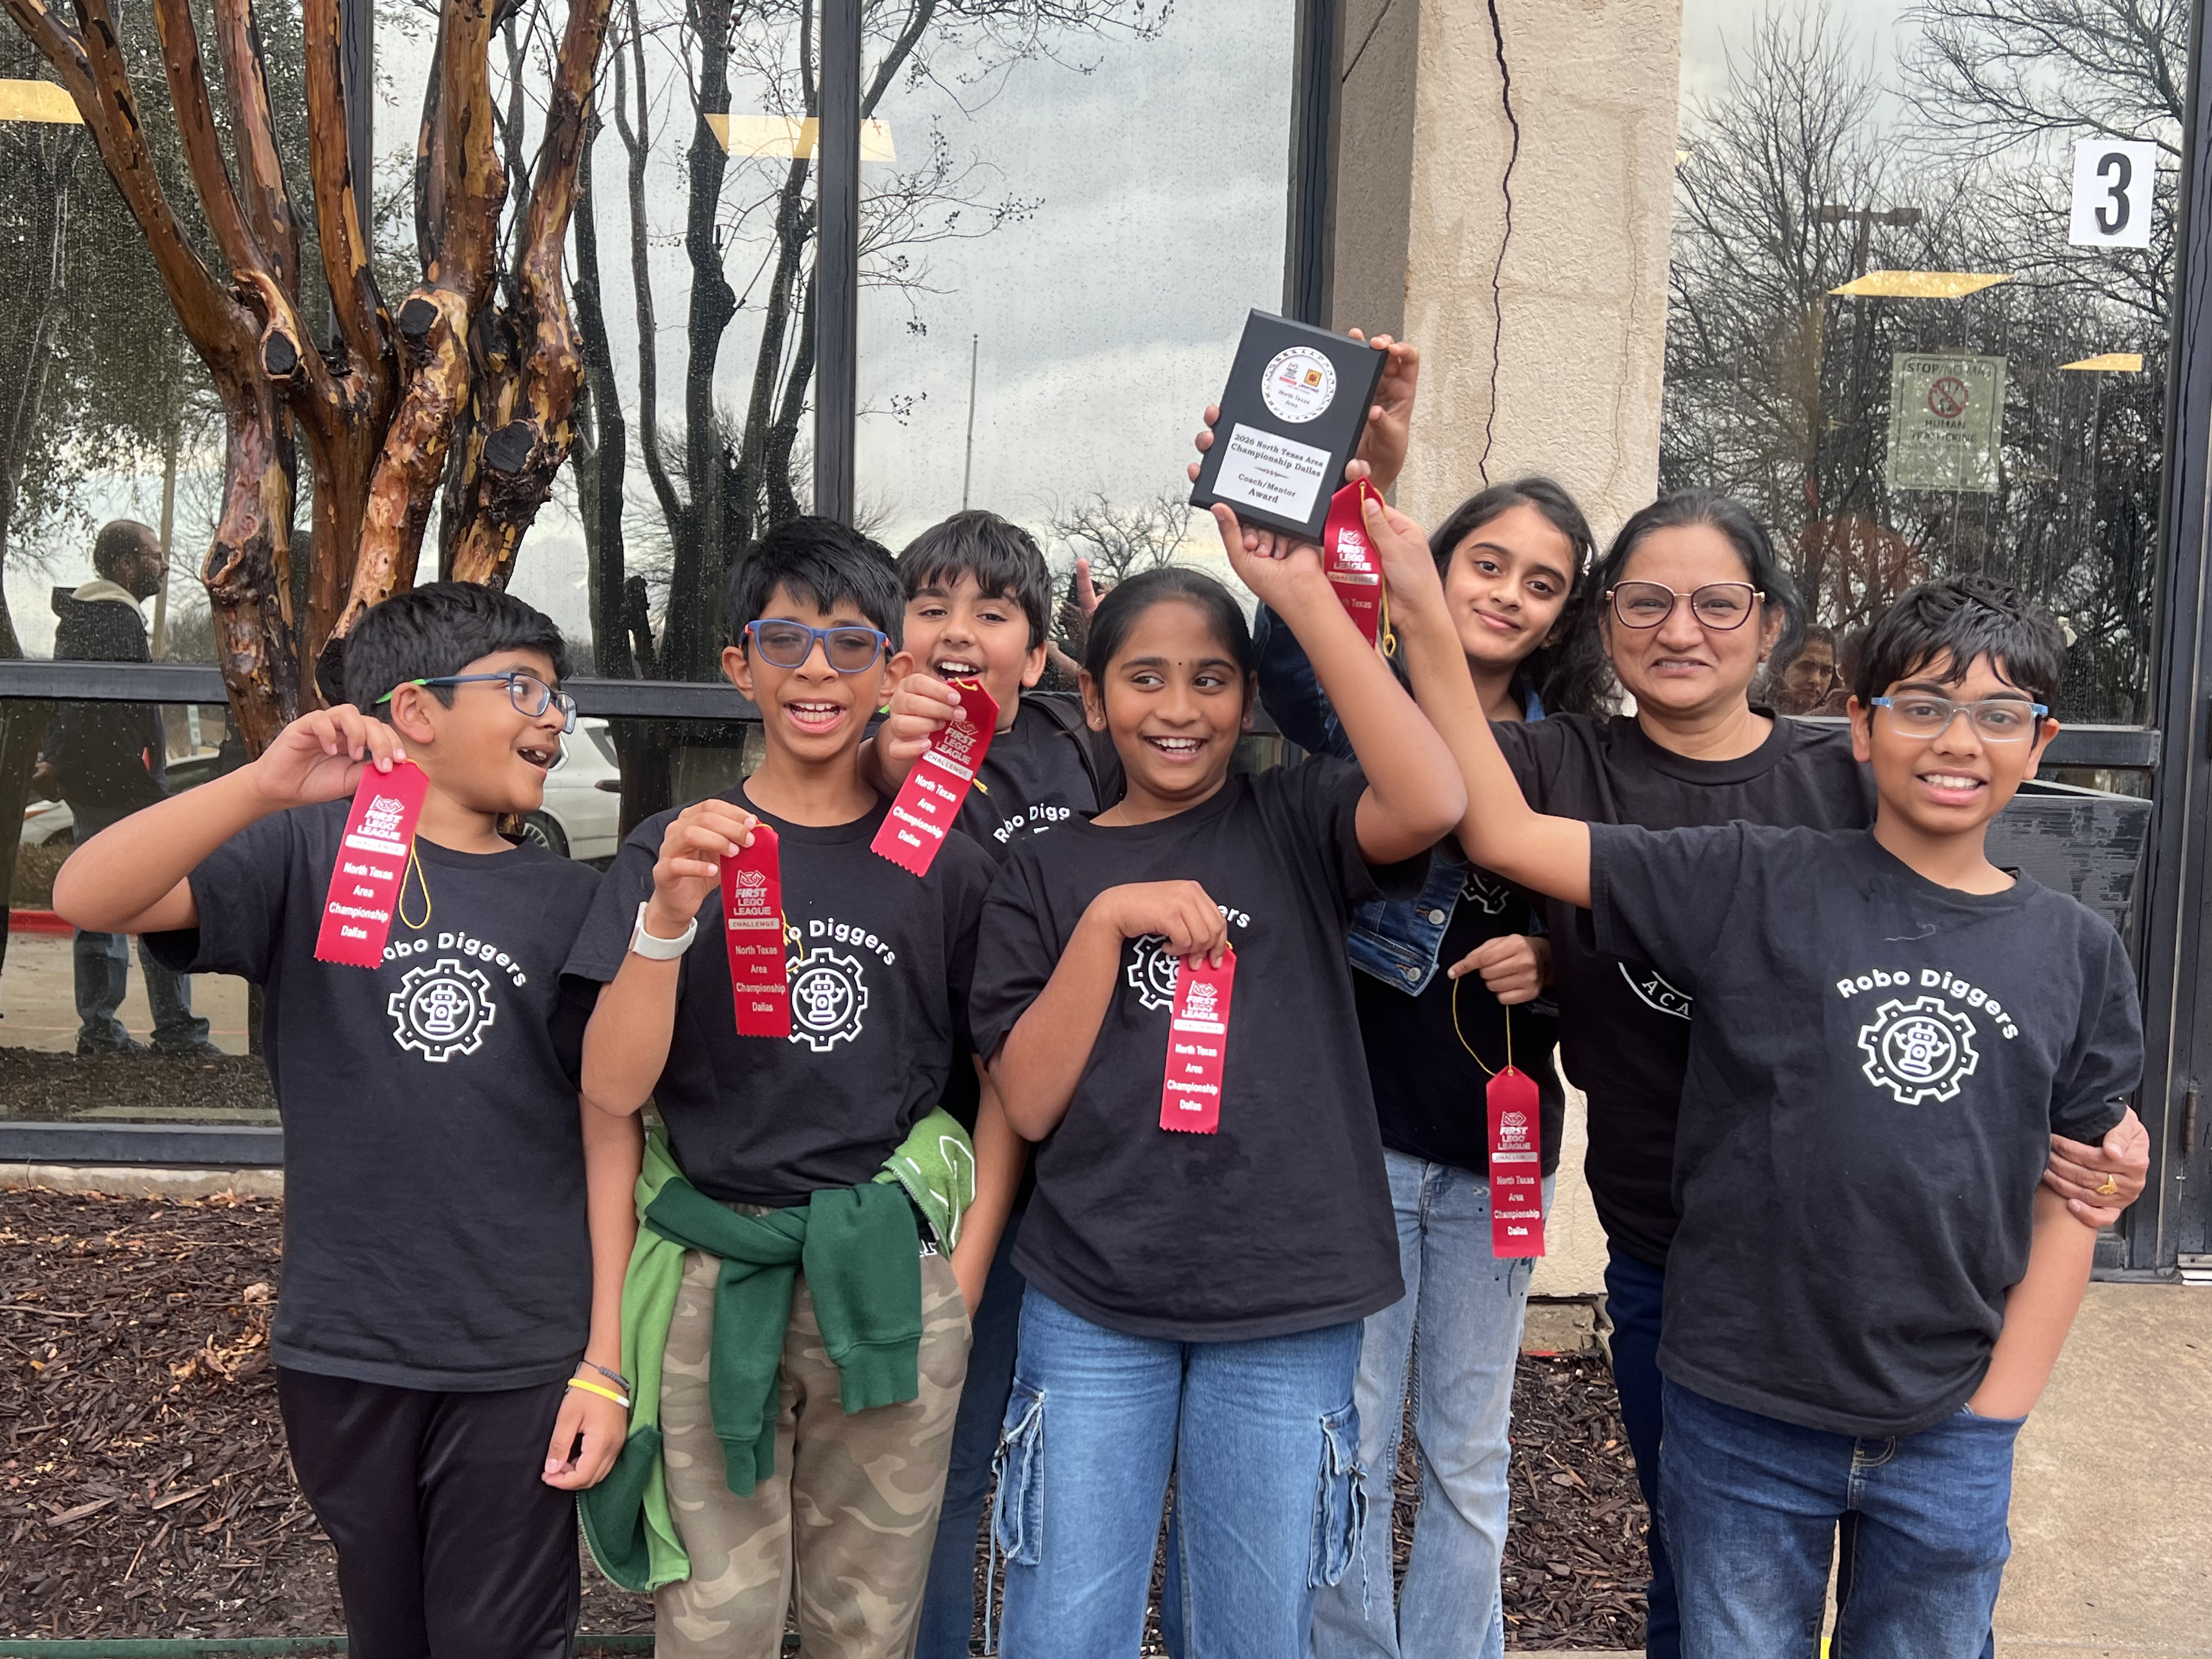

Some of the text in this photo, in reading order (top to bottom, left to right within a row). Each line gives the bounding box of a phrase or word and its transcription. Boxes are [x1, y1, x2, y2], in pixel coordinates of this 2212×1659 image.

[2095, 153, 2132, 235] 3
[1278, 389, 1294, 399] North
[1926, 419, 1966, 429] HUMAN
[1234, 433, 1323, 467] 2026 North Texas Area
[1231, 443, 1321, 477] Championship Dallas
[1238, 473, 1296, 498] Coach/Mentor
[1248, 488, 1279, 504] Award
[1339, 553, 1364, 562] LEGO
[1333, 562, 1372, 571] LEAGUE
[1351, 598, 1372, 608] Texas
[944, 727, 977, 747] FIRST
[944, 736, 970, 753] LEGO
[934, 741, 972, 765] LEAGUE
[927, 754, 968, 776] CHALLENGE
[915, 774, 956, 802] North Texas
[917, 798, 936, 814] Area
[1029, 803, 1070, 821] Digg
[364, 809, 403, 823] FIRST
[893, 806, 943, 838] Championship
[365, 818, 396, 831] LEGO
[357, 825, 401, 841] LEAGUE
[898, 830, 921, 847] Dallas
[343, 862, 393, 880] North Texas
[352, 884, 374, 898] Area
[735, 888, 767, 898] FIRST
[738, 898, 764, 906] LEGO
[329, 901, 388, 923] Championship
[733, 906, 771, 915] LEAGUE
[341, 925, 367, 939] Dallas
[809, 917, 895, 966] Diggers
[735, 945, 777, 955] North Texas
[380, 932, 526, 987] obo Diggers
[751, 964, 768, 973] Area
[736, 982, 786, 995] Championship
[752, 1002, 774, 1012] Dallas
[1186, 995, 1217, 1006] FIRST
[1187, 1003, 1213, 1012] LEGO
[1836, 968, 2019, 1040] Robo Diggers
[1181, 1009, 1218, 1021] LEAGUE
[1175, 1043, 1217, 1057] North Texas
[1185, 1063, 1203, 1074] Area
[1167, 1079, 1218, 1096] Championship
[1180, 1099, 1201, 1111] Dallas
[1499, 1126, 1528, 1136] FIRST
[1497, 1142, 1531, 1150] LEAGUE
[1497, 1176, 1534, 1185] North Texas
[1508, 1193, 1524, 1201] Area
[1494, 1209, 1540, 1220] Championship
[1507, 1226, 1528, 1235] Dallas
